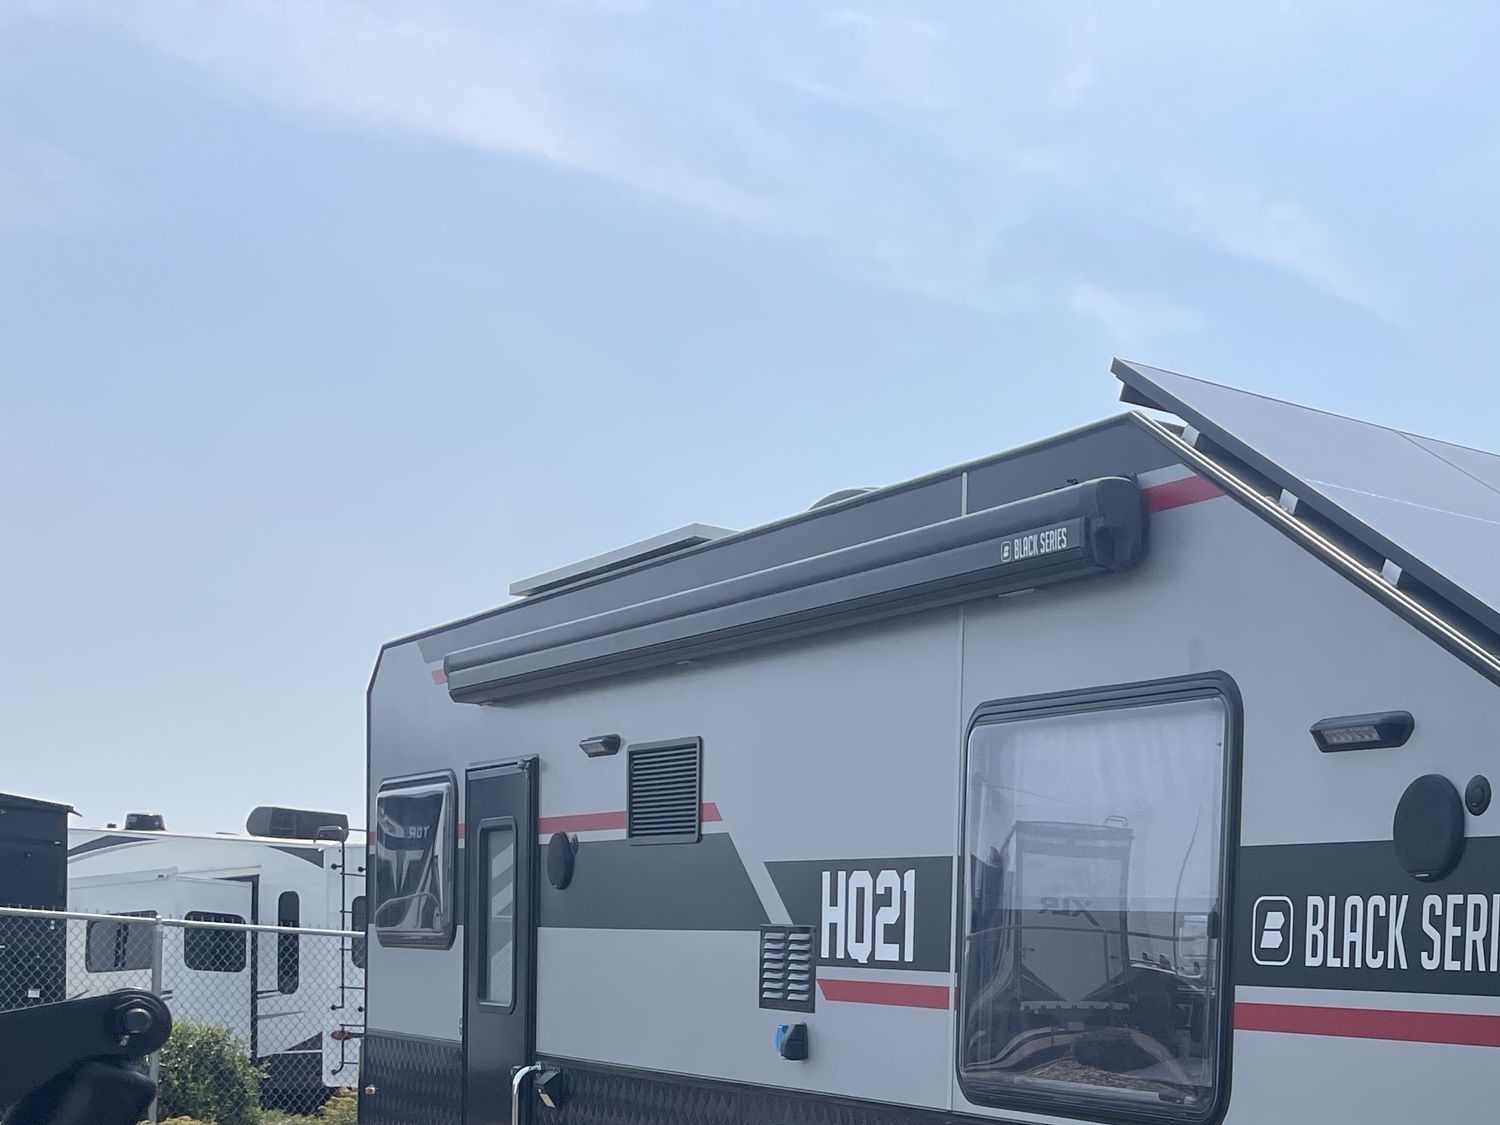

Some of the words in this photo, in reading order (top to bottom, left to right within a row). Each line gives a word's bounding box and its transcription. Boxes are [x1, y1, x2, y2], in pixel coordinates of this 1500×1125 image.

[1014, 534, 1039, 560] BLACK
[1040, 527, 1067, 553] SERIES
[821, 869, 916, 963] HQ21
[1304, 895, 1409, 969] BLACK
